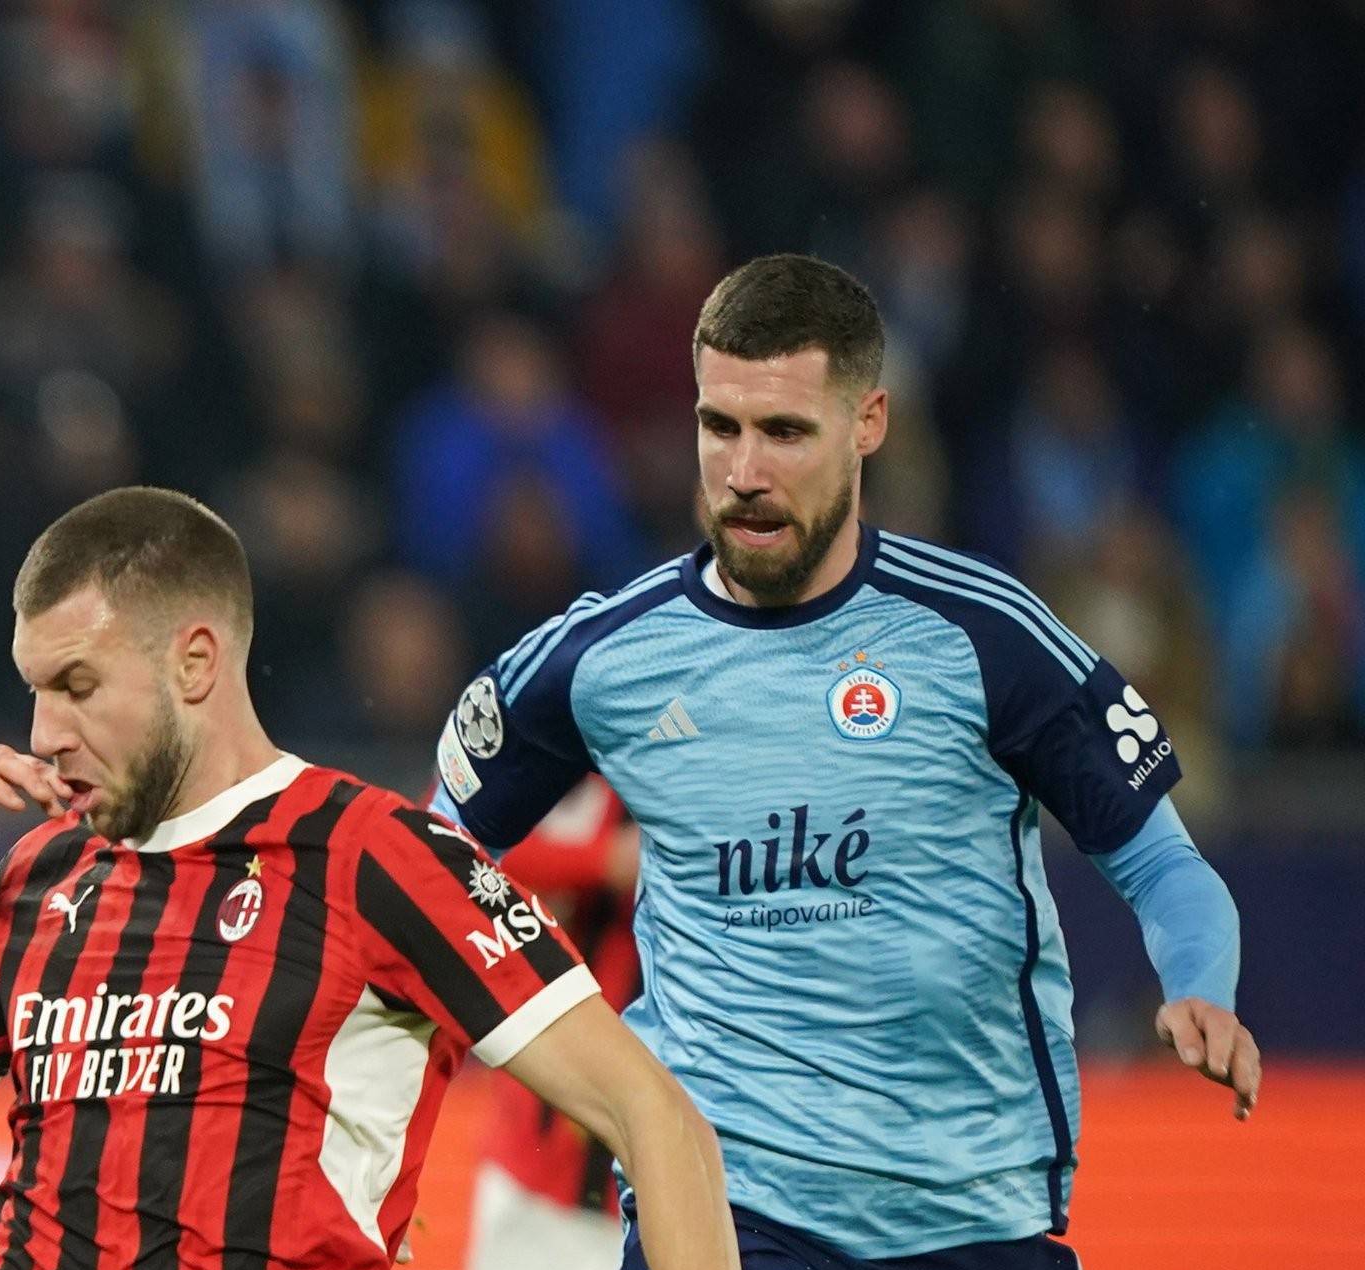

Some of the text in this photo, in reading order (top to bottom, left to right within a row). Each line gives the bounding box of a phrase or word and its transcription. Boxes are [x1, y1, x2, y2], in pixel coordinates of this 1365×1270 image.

[1127, 738, 1172, 791] MILLIO
[712, 803, 870, 896] niké
[721, 896, 874, 932] je tipovanie
[12, 982, 235, 1052] Emirates
[30, 1044, 186, 1104] FLY BETTER
